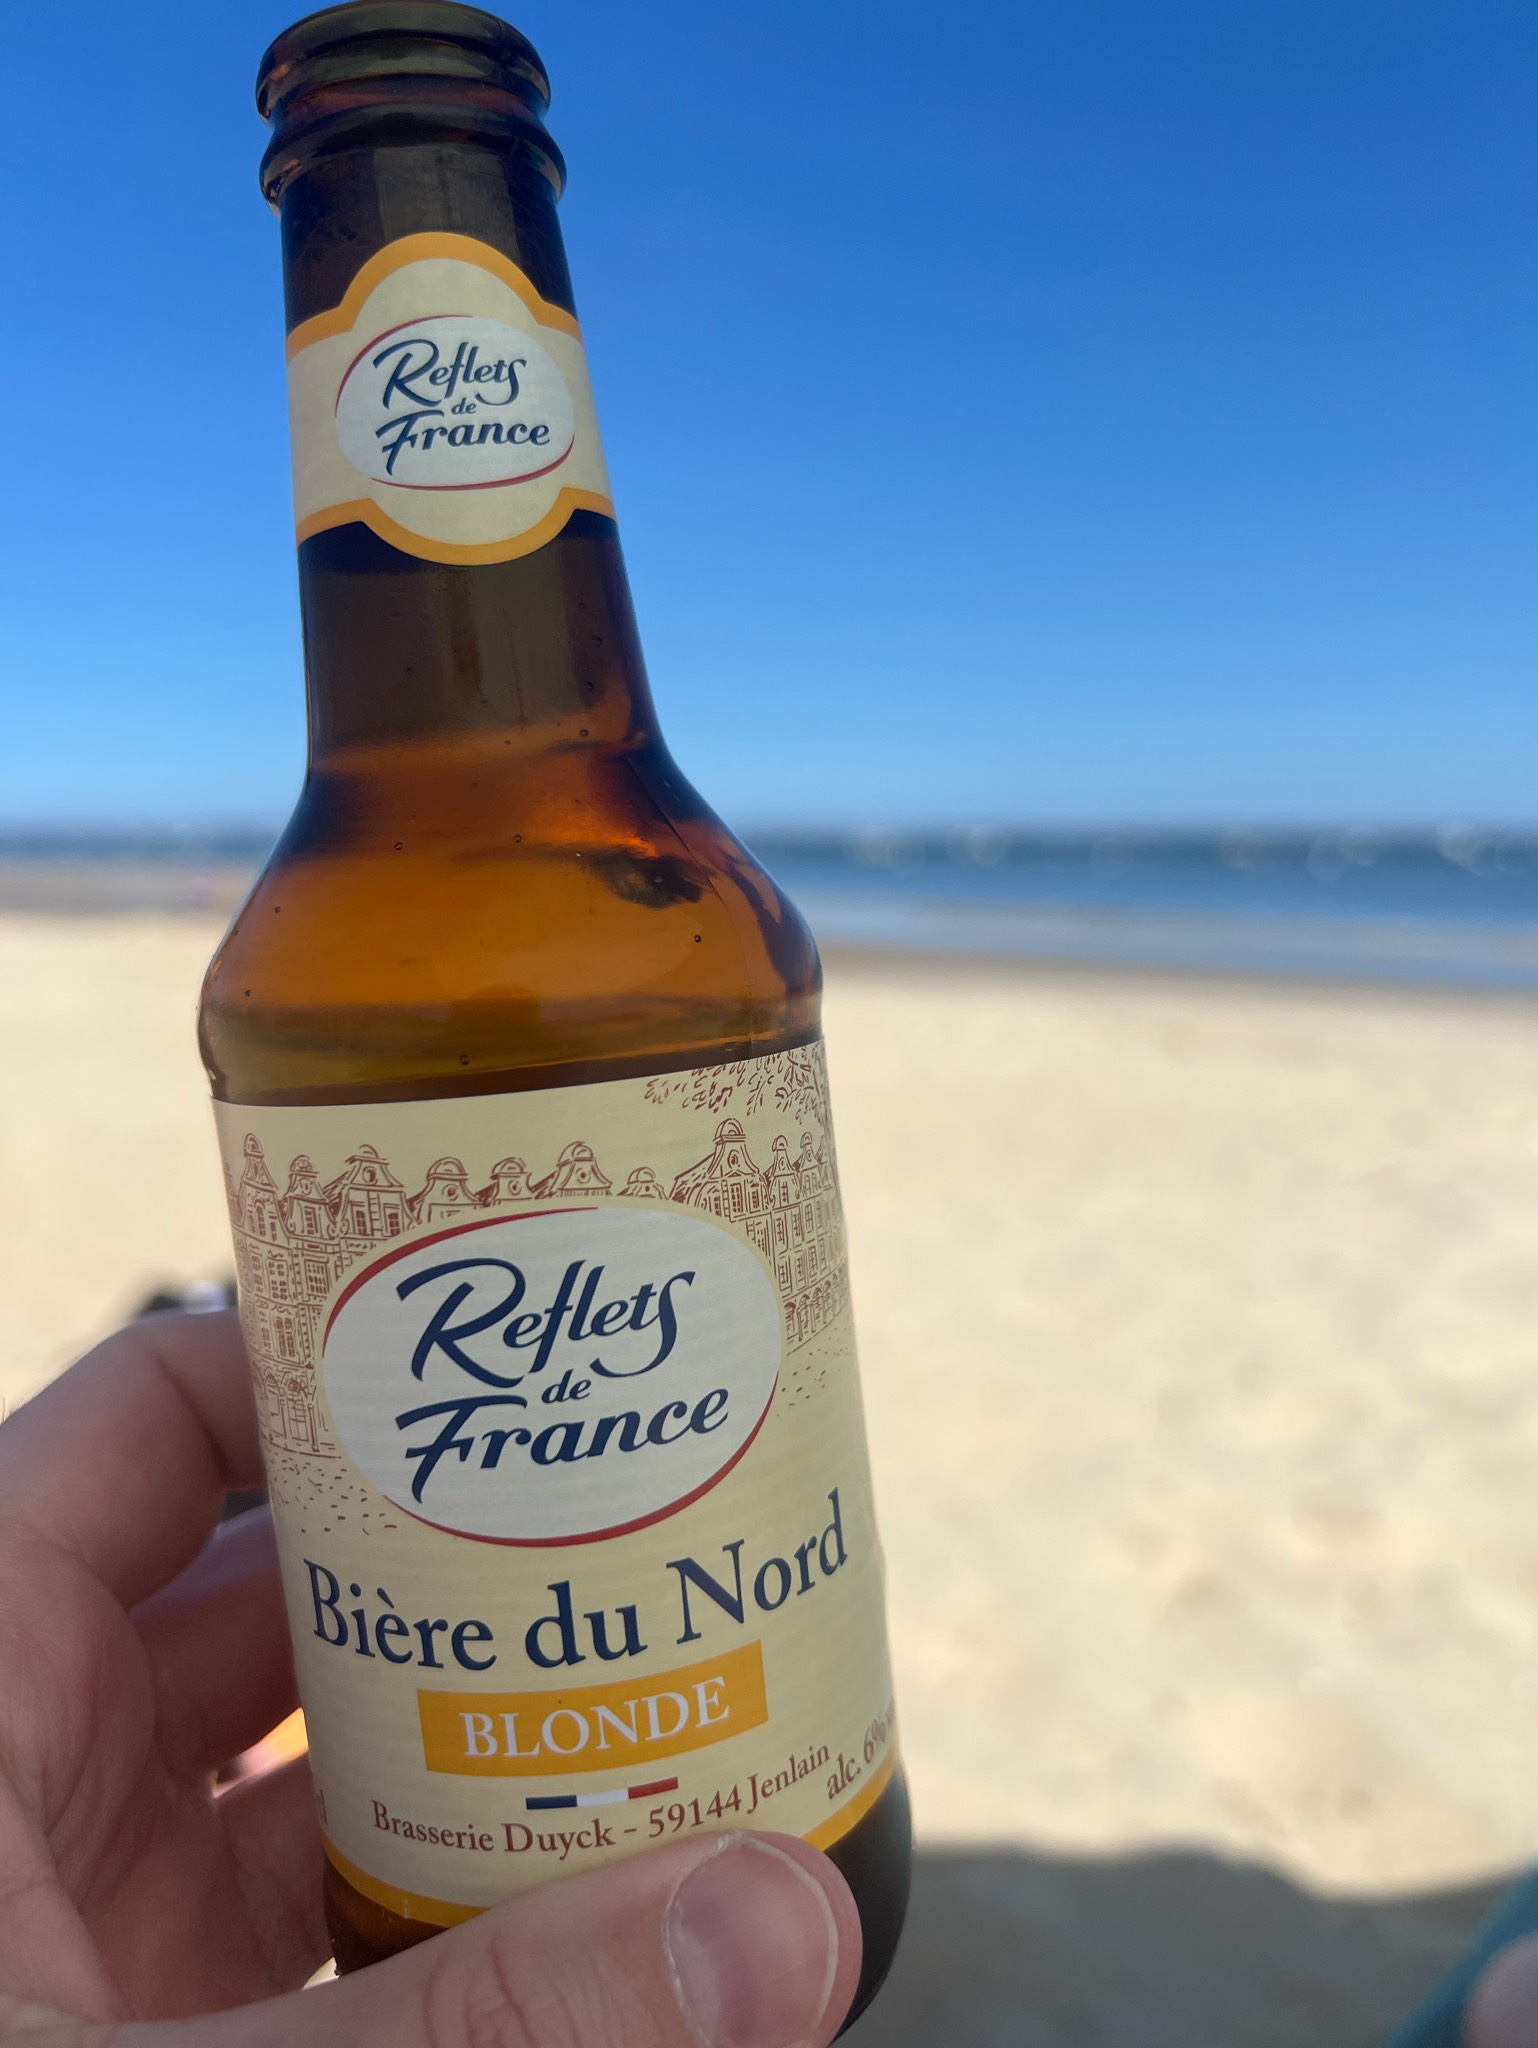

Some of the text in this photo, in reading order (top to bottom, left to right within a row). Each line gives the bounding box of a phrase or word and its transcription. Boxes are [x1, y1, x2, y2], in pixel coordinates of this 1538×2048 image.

[373, 338, 527, 410] Reflets
[451, 397, 477, 415] de
[375, 410, 550, 476] France
[395, 1257, 696, 1388] Reflets
[541, 1369, 592, 1403] de
[395, 1388, 730, 1504] France
[303, 1486, 849, 1672] Bière du Nord
[459, 1675, 730, 1758] BLONDE
[371, 1799, 495, 1852] Brasserie
[503, 1817, 616, 1860] Duyck
[648, 1790, 742, 1838] 59144
[745, 1744, 831, 1815] Jenlain
[826, 1752, 862, 1801] alc.
